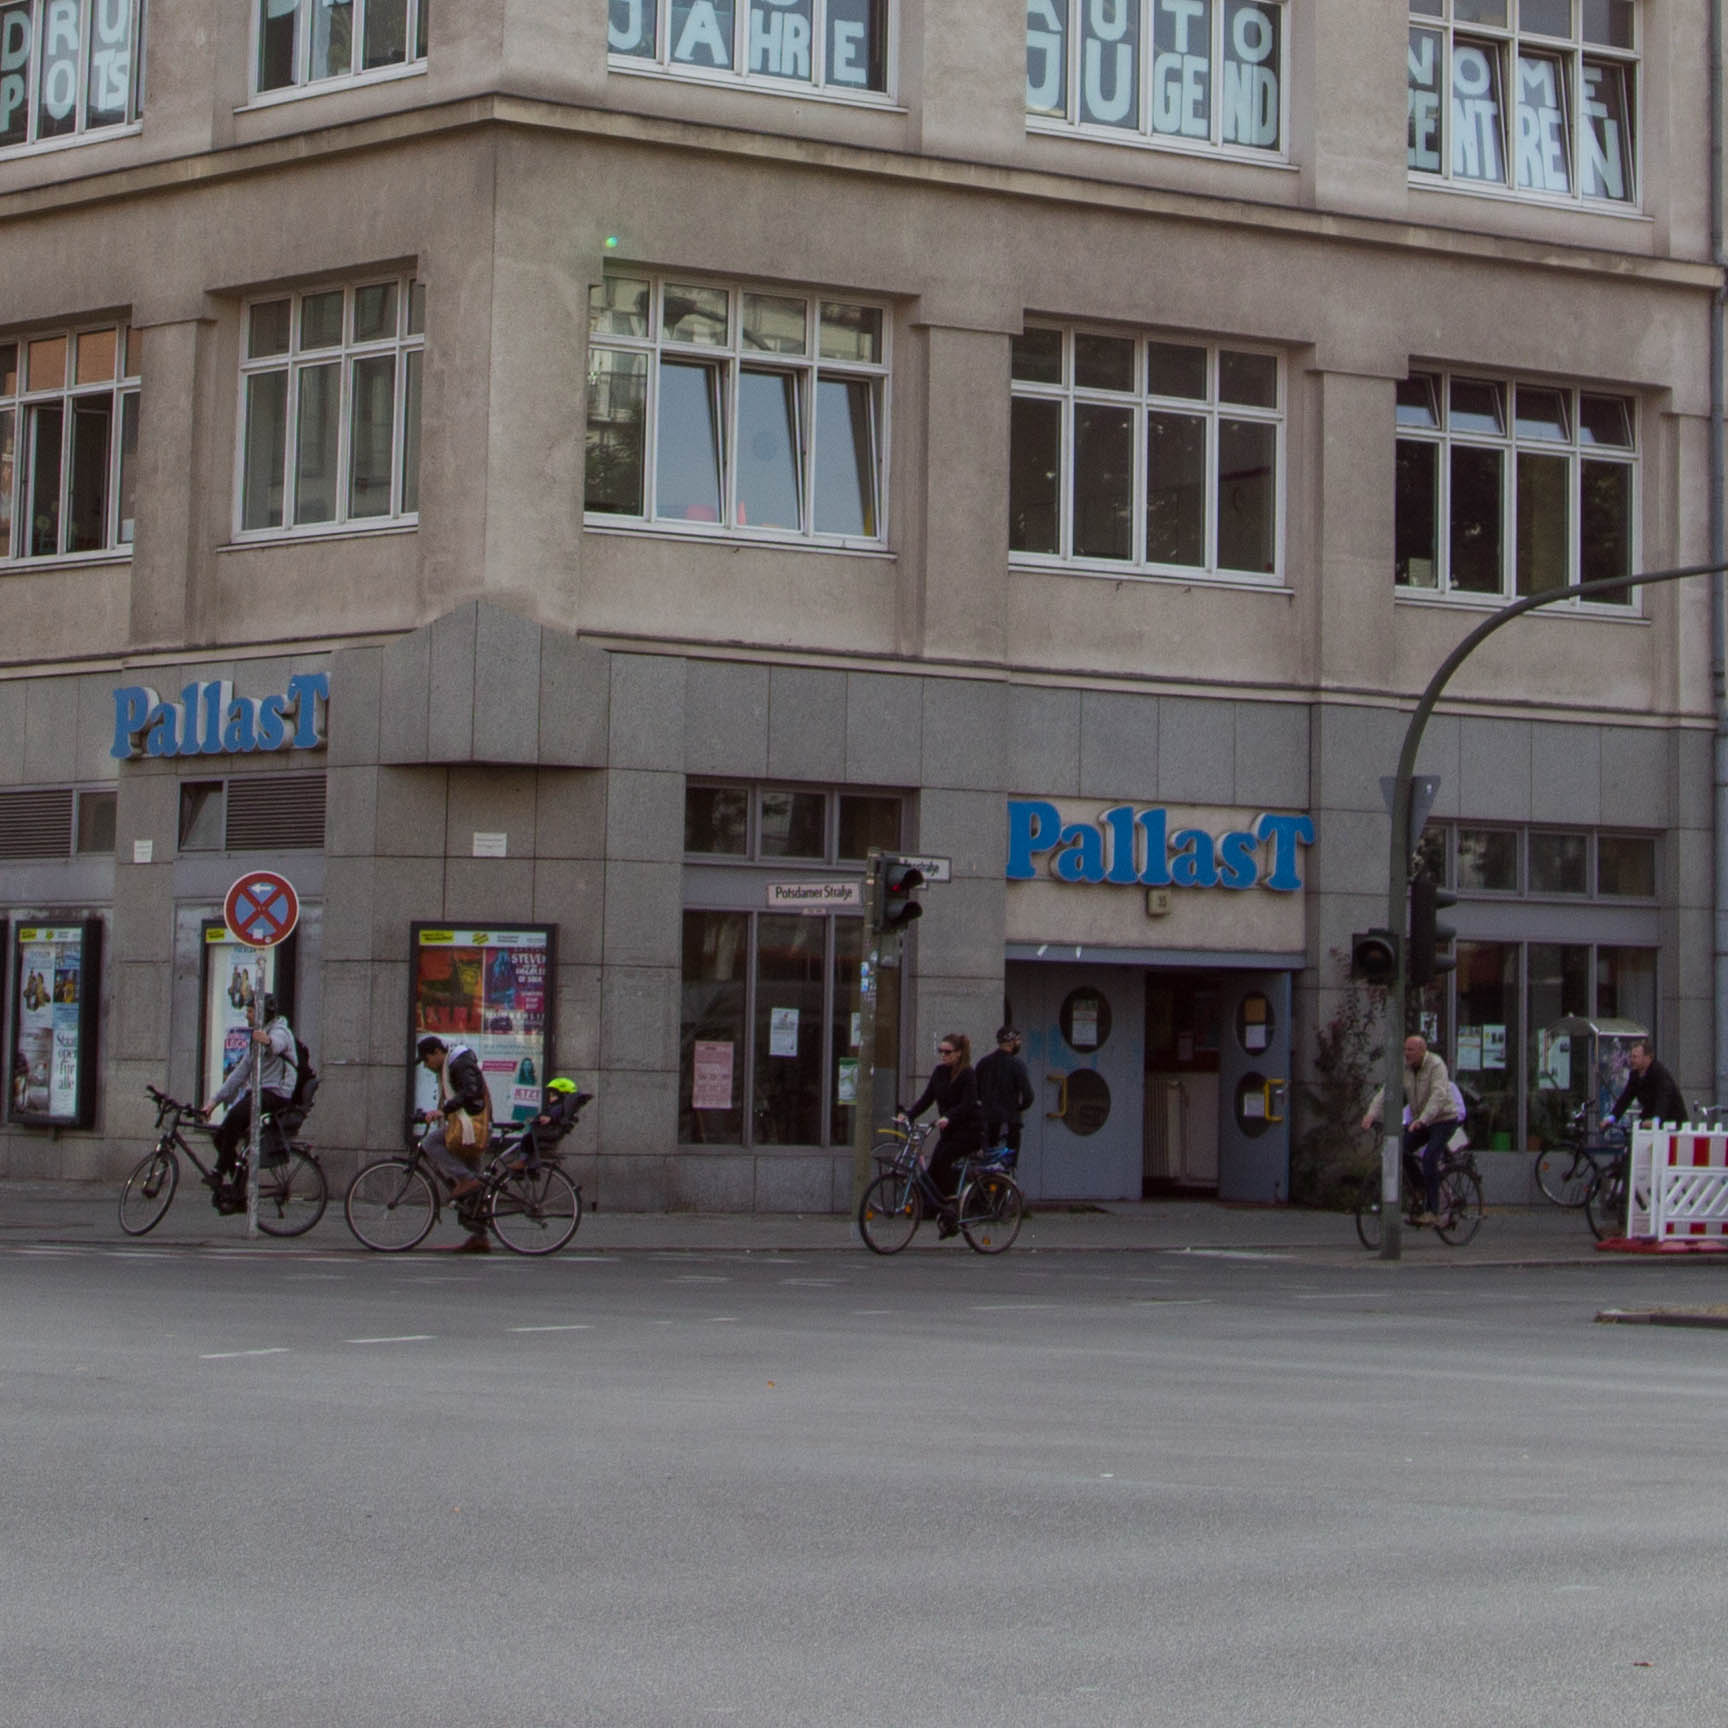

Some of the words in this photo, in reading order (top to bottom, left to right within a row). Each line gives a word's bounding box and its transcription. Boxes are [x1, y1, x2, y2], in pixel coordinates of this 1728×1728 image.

[1026, 30, 1278, 146] JUGEND
[1408, 36, 1608, 118] NOME
[110, 672, 330, 758] PallasT
[1006, 800, 1315, 891] PallasT
[775, 885, 822, 898] Potsdamer
[824, 885, 853, 901] Straße
